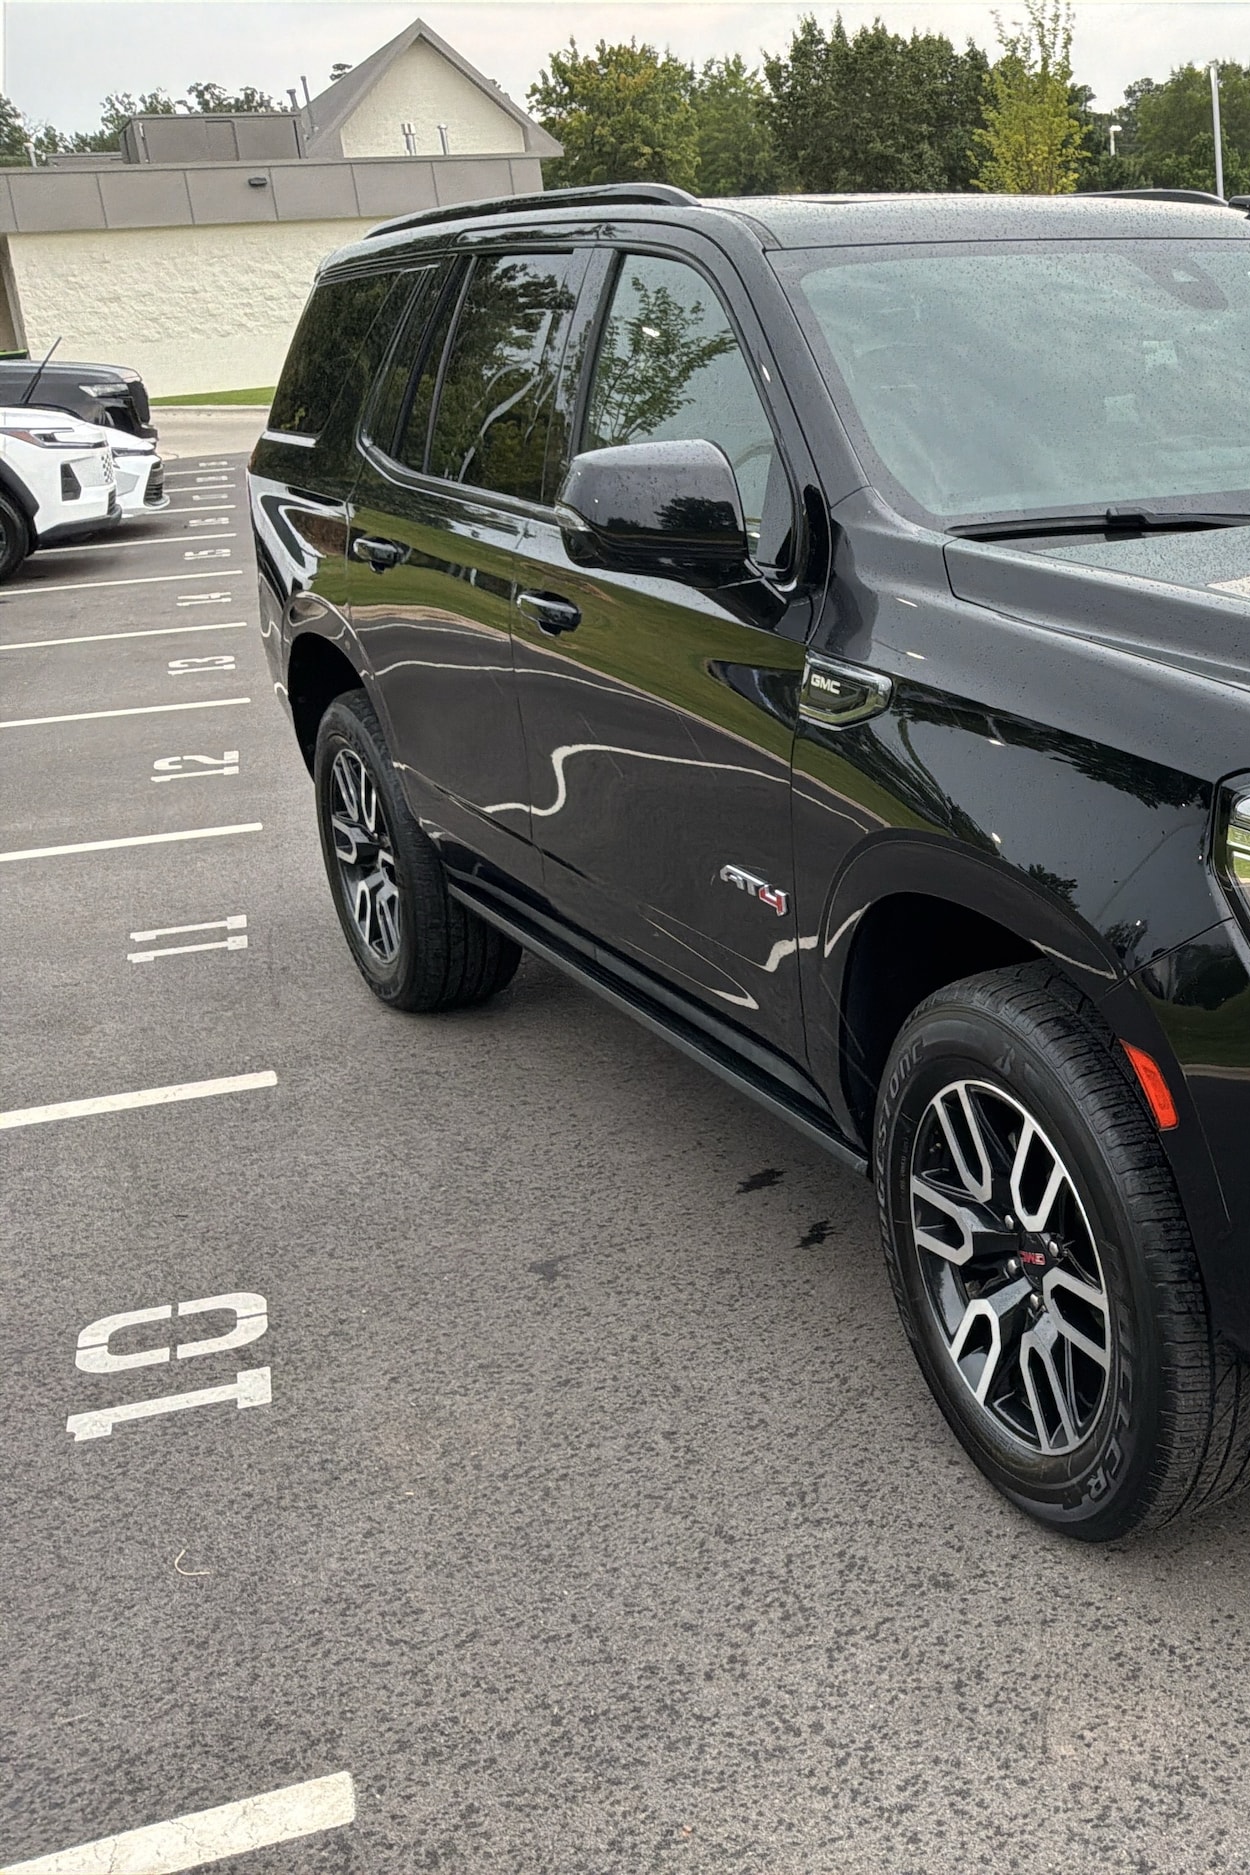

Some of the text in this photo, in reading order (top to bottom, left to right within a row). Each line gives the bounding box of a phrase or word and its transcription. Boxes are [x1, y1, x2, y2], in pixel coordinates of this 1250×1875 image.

[168, 655, 236, 675] 13
[810, 674, 841, 695] GMC
[151, 750, 239, 782] 12
[720, 865, 787, 916] AT4
[127, 914, 248, 963] 11
[66, 1292, 272, 1441] 10
